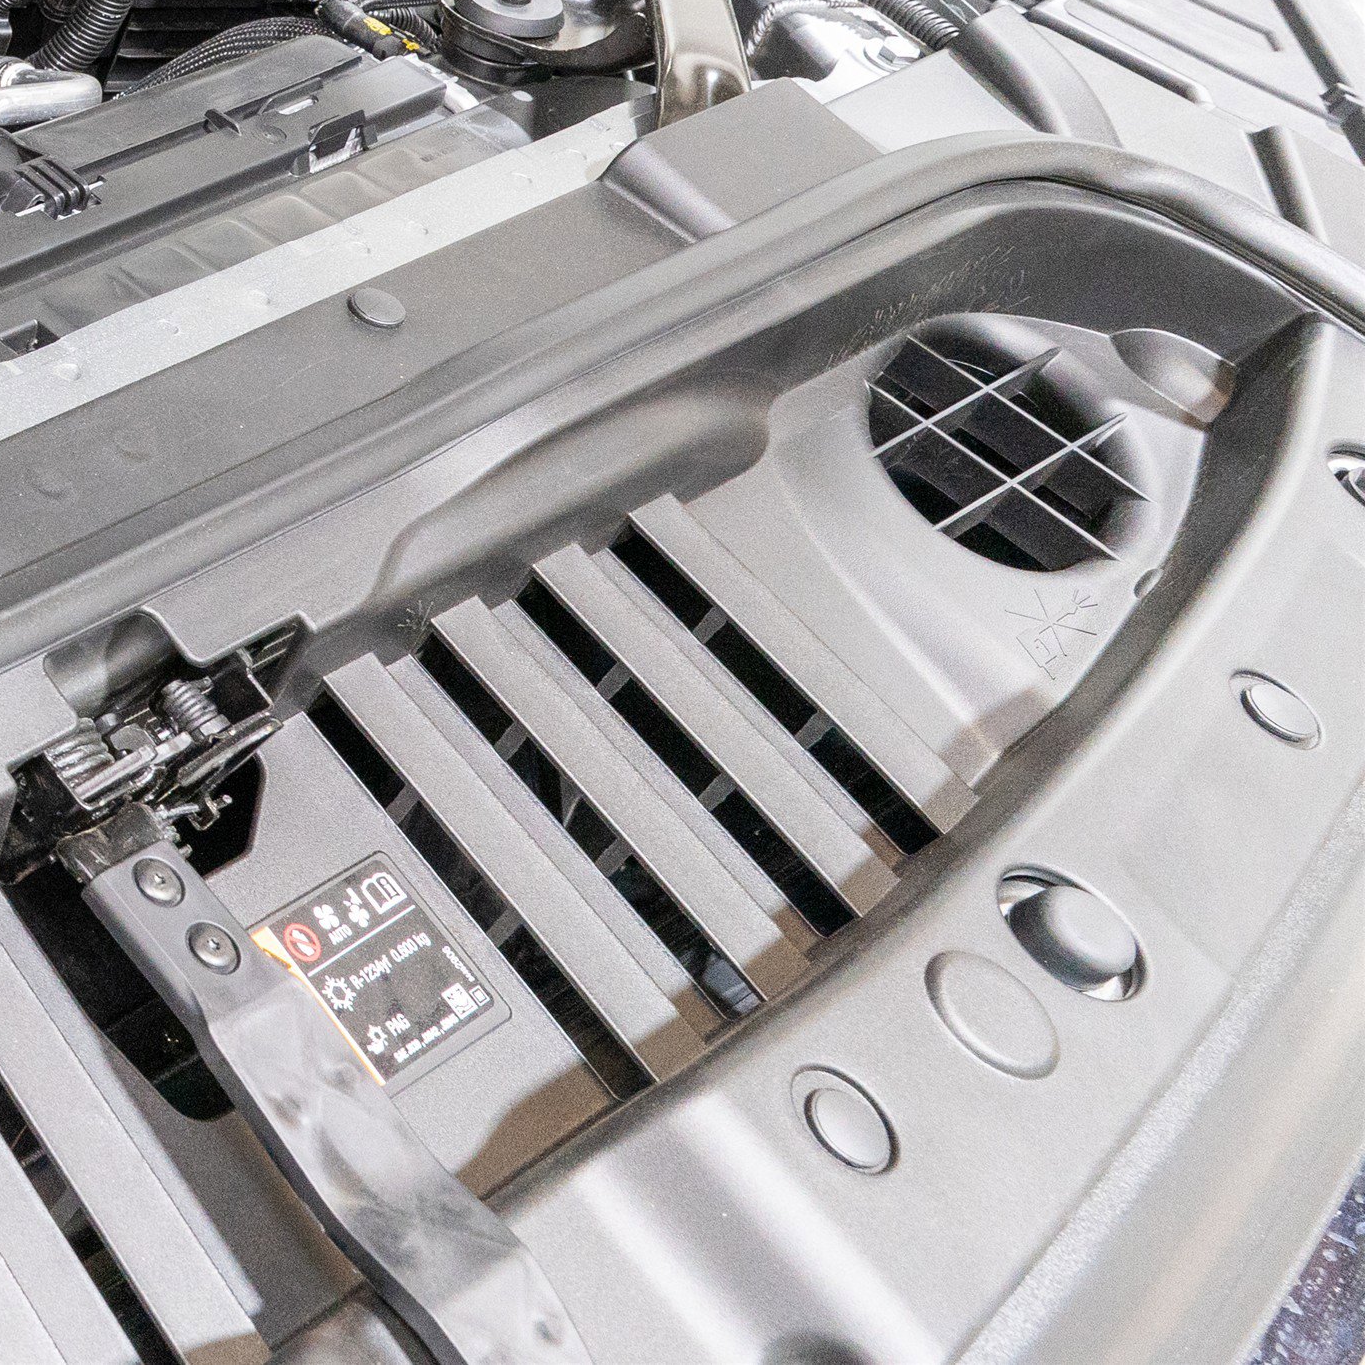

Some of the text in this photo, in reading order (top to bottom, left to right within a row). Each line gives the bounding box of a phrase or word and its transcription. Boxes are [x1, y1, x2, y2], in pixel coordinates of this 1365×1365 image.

[328, 923, 353, 946] AUTO
[349, 932, 432, 990] R-1234yf 0.600 kg
[385, 1013, 411, 1037] PAG
